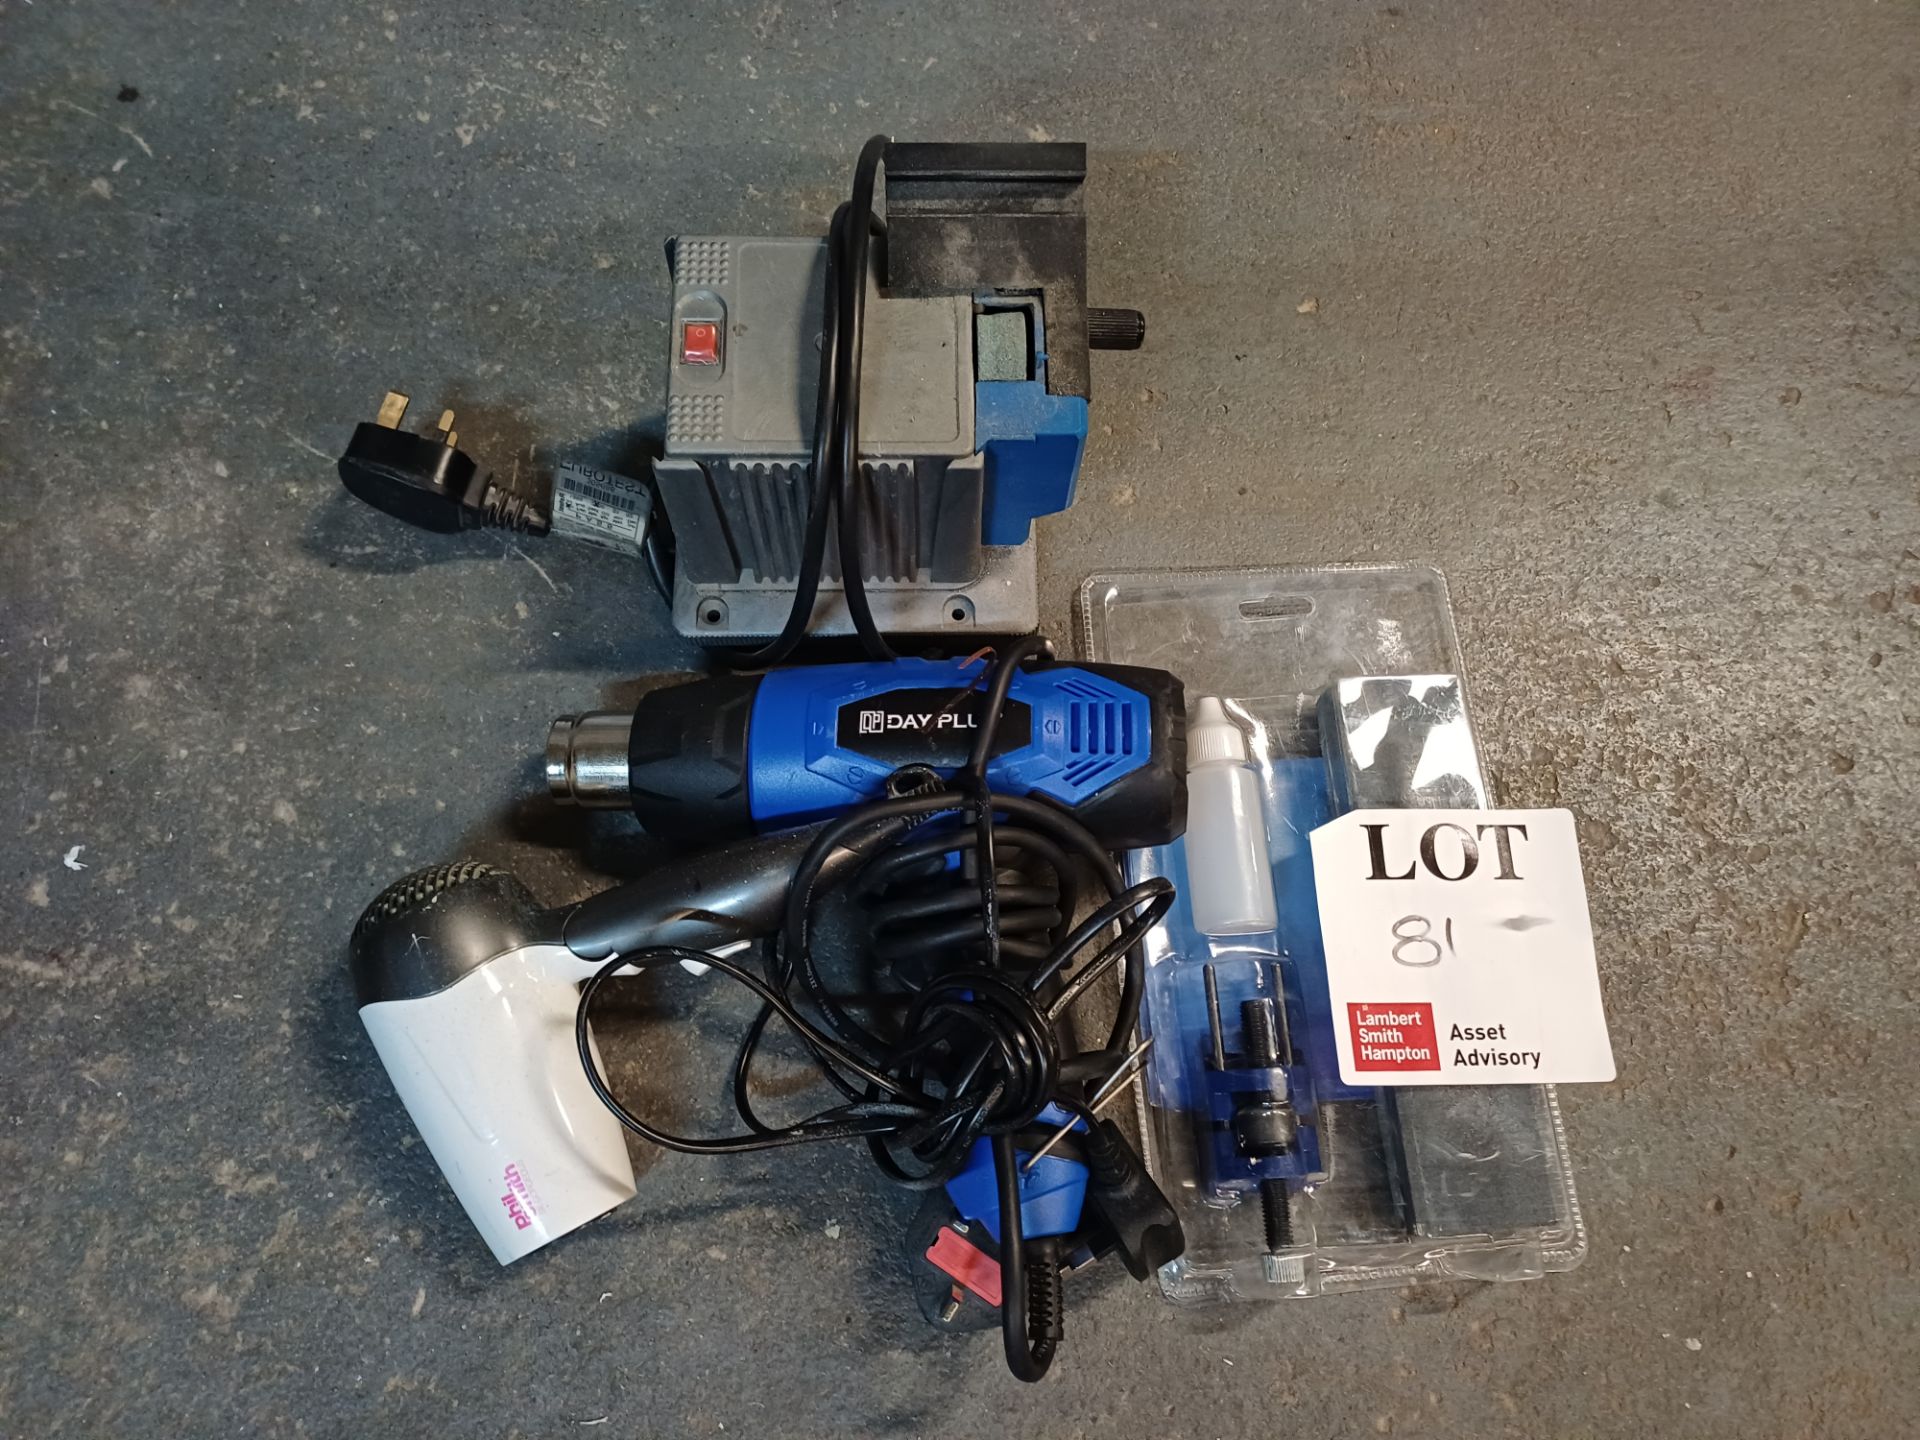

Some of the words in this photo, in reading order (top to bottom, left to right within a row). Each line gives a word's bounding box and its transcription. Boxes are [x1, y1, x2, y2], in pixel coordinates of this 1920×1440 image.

[887, 714, 933, 729] DAY
[1359, 822, 1529, 882] LOT
[1391, 914, 1457, 968] 81
[1356, 1010, 1422, 1026] Lambert
[1359, 1028, 1404, 1044] Smith
[1449, 1023, 1507, 1042] Asset
[1361, 1045, 1431, 1064] Hampton
[1453, 1048, 1541, 1069] Advisory
[501, 1193, 532, 1231] phil
